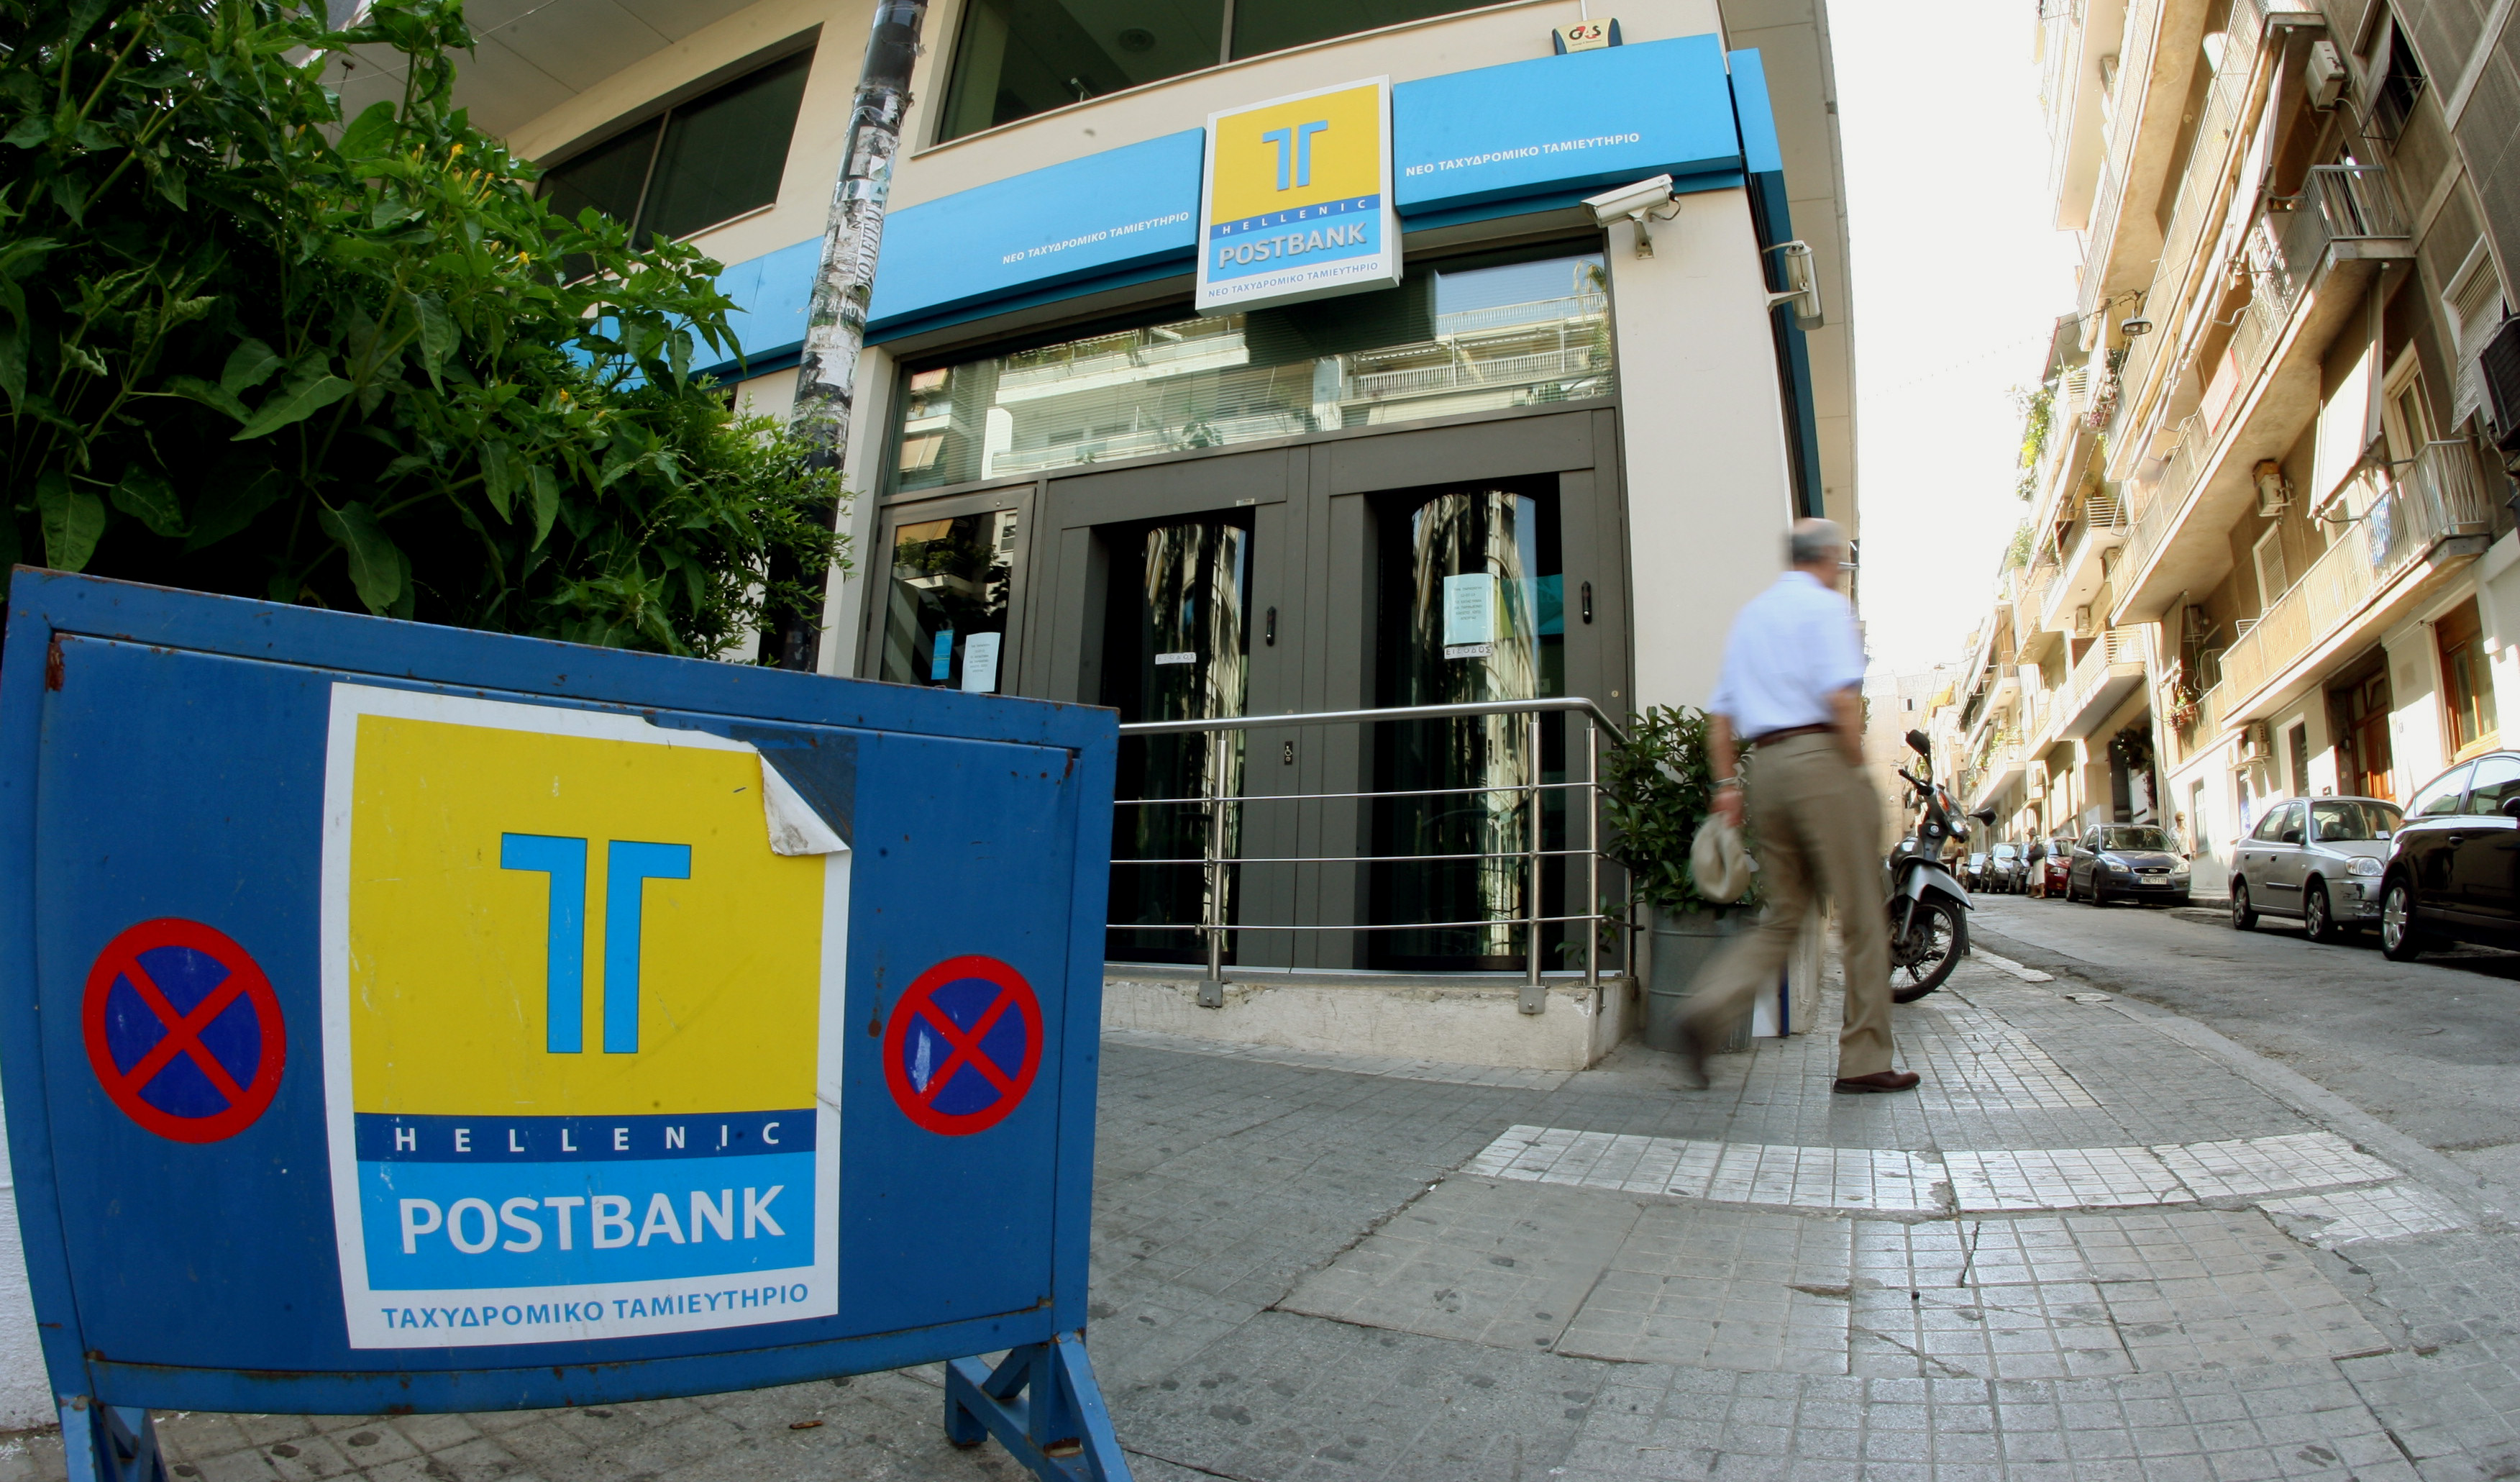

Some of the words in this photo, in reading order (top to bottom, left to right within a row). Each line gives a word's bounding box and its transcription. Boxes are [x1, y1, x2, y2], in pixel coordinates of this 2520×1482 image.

[1405, 163, 1434, 177] ΝΕΟ
[1438, 146, 1539, 171] ΤΑΧΥΔΡΟΜΙΚΟ
[1542, 132, 1640, 154] ΤΑΜΙΕΥΤΗΡΙΟ
[1002, 251, 1025, 265] ΝΕΟ
[1028, 231, 1107, 258] ΤΑΧΥΔΡΟΜΙΚΟ
[1109, 212, 1189, 237] ΤΑΜΙΕΥΤΗΡΙΟ
[1223, 199, 1366, 235] HELLENIC
[1218, 222, 1367, 269] POSTBANK
[1208, 287, 1229, 298] ΝΕΟ
[1231, 274, 1305, 292] ΤΑΧΥΔΡΟΜΙΚΟ
[1307, 262, 1379, 280] ΤΑΜΙΕΥΤΗΡΙΟ
[395, 1122, 780, 1153] HELLENIC
[398, 1184, 786, 1255] POSTBANK
[381, 1300, 605, 1329] ΤΑΧΥΔΡΟΜΙΚΟ
[613, 1283, 809, 1318] ΤΑΜΙΕΥΤΗΡΙΟ
